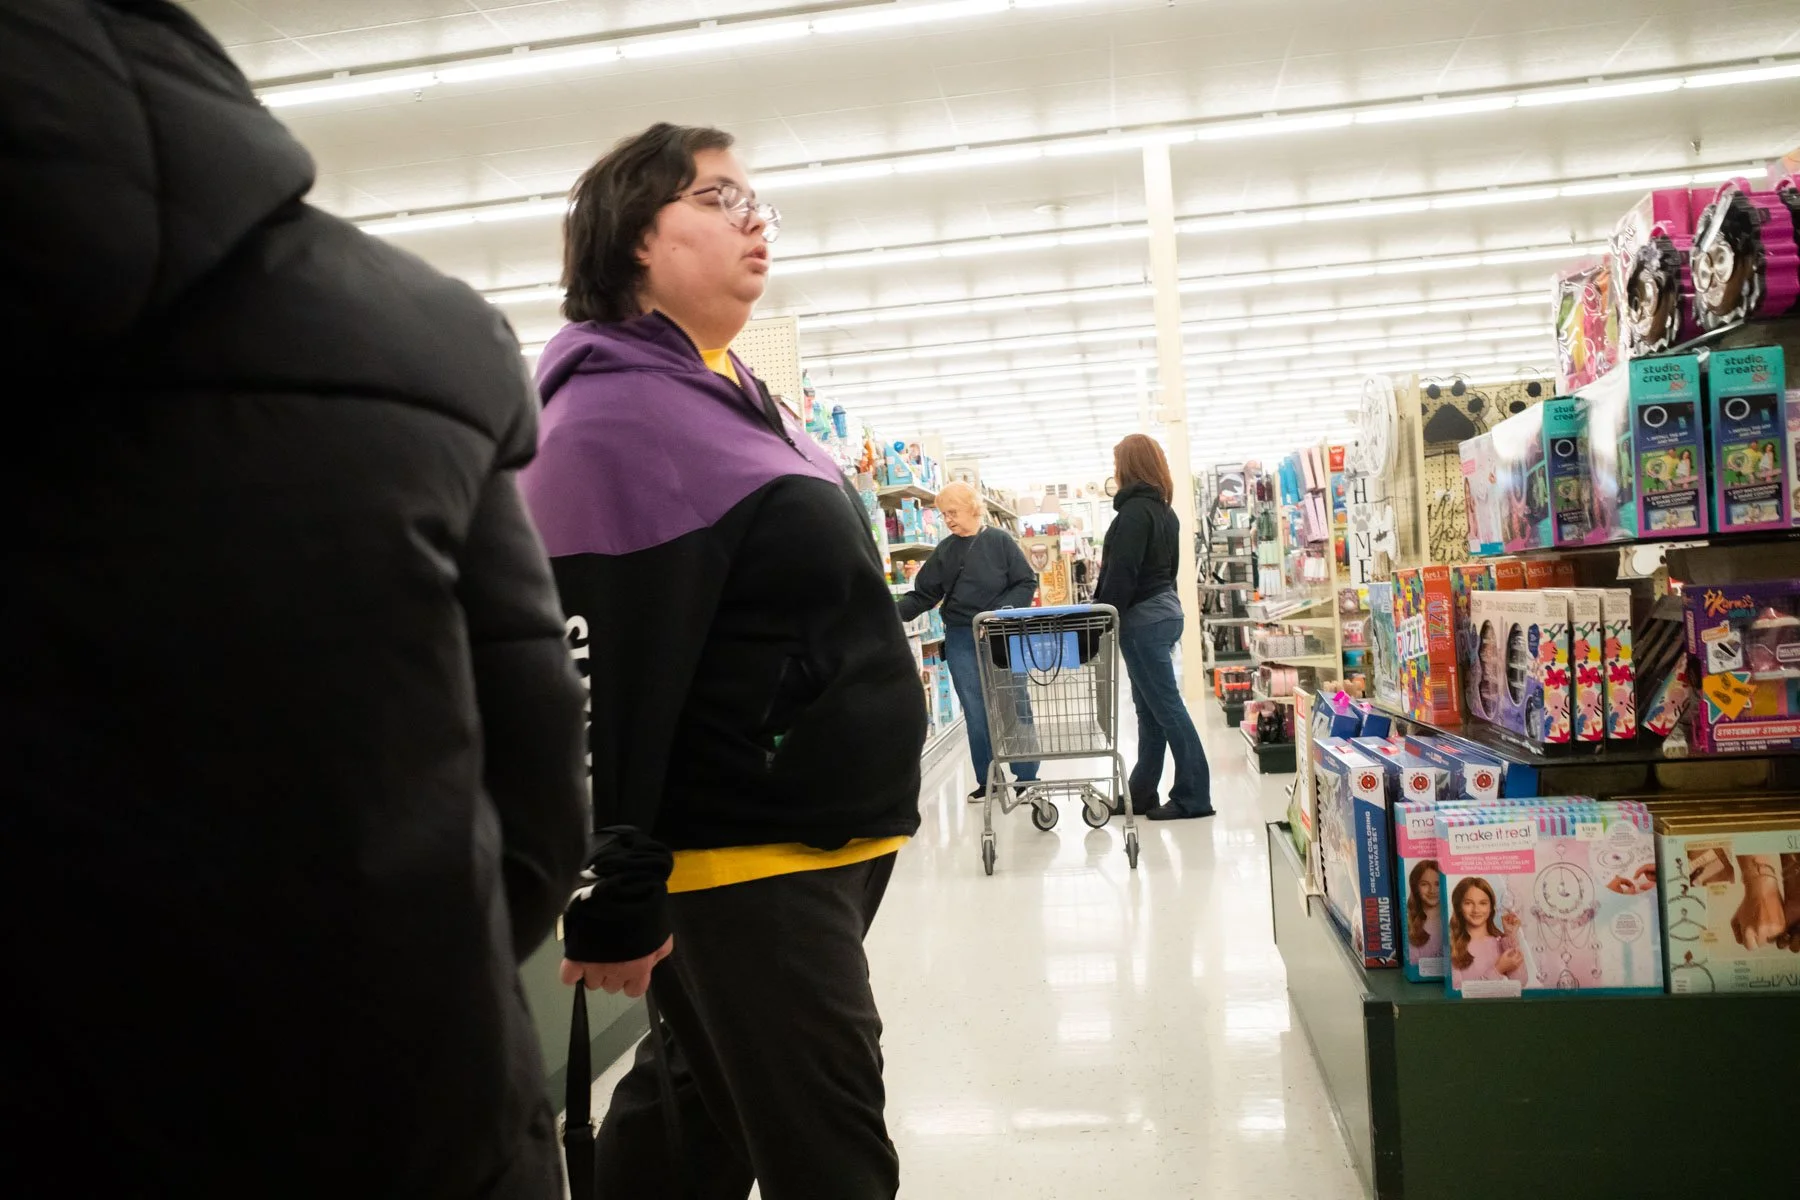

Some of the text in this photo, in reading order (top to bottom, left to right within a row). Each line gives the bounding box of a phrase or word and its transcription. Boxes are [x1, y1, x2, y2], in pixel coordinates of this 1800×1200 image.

[1725, 354, 1761, 366] studio
[1643, 363, 1680, 374] studio
[1724, 363, 1768, 375] creator
[1643, 371, 1685, 383] creator
[1554, 405, 1575, 414] stud
[1554, 413, 1577, 421] crea
[1353, 479, 1371, 584] HME
[1426, 592, 1445, 651] PUZZLE
[1717, 726, 1797, 737] STATEMENT STAMPER
[1412, 816, 1436, 828] ma
[1455, 826, 1531, 843] make it real
[1365, 811, 1376, 894] CREATIVE COLORING
[1366, 898, 1381, 952] BEYOND
[1378, 897, 1392, 950] AMAZING
